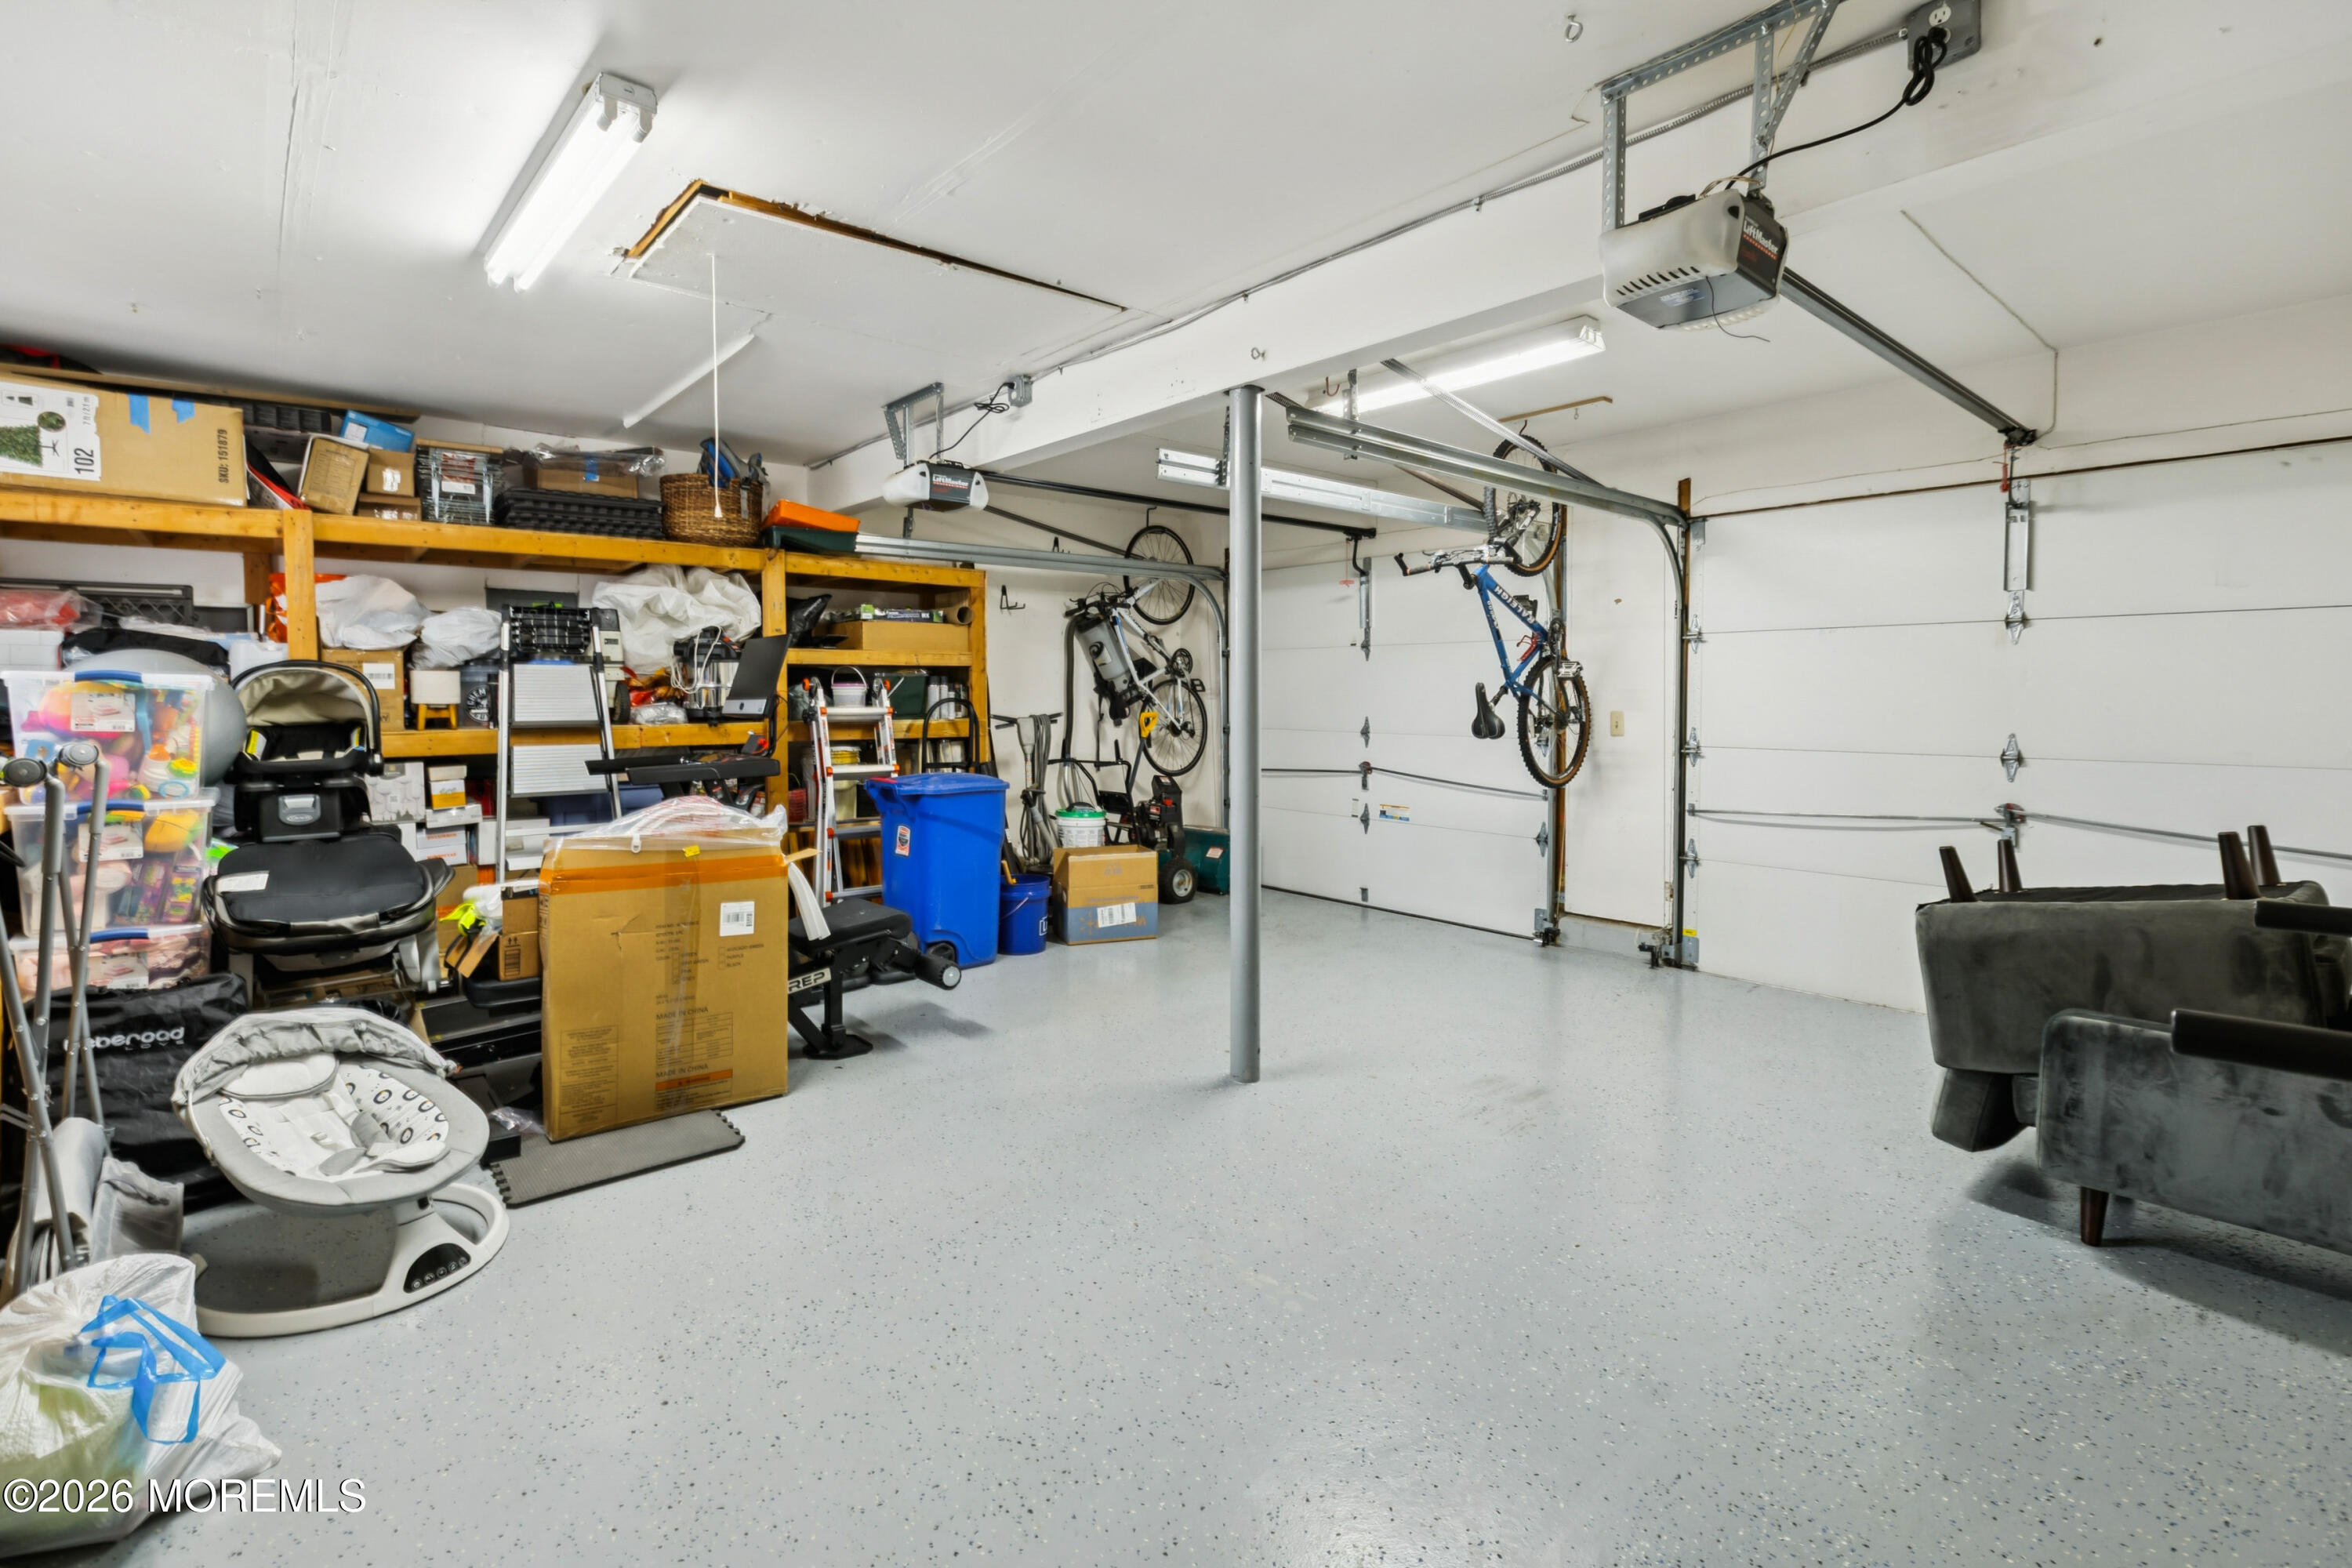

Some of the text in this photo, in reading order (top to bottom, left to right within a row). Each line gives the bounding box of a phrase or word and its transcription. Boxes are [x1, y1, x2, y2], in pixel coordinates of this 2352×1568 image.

[74, 448, 95, 474] 102
[217, 428, 230, 484] SKU: 151879
[1494, 584, 1536, 624] RALEIGH
[789, 971, 826, 993] REP
[656, 1011, 676, 1020] MADE
[688, 1006, 709, 1015] CHINA
[656, 1069, 676, 1078] MADE
[687, 1063, 709, 1073] CHINA
